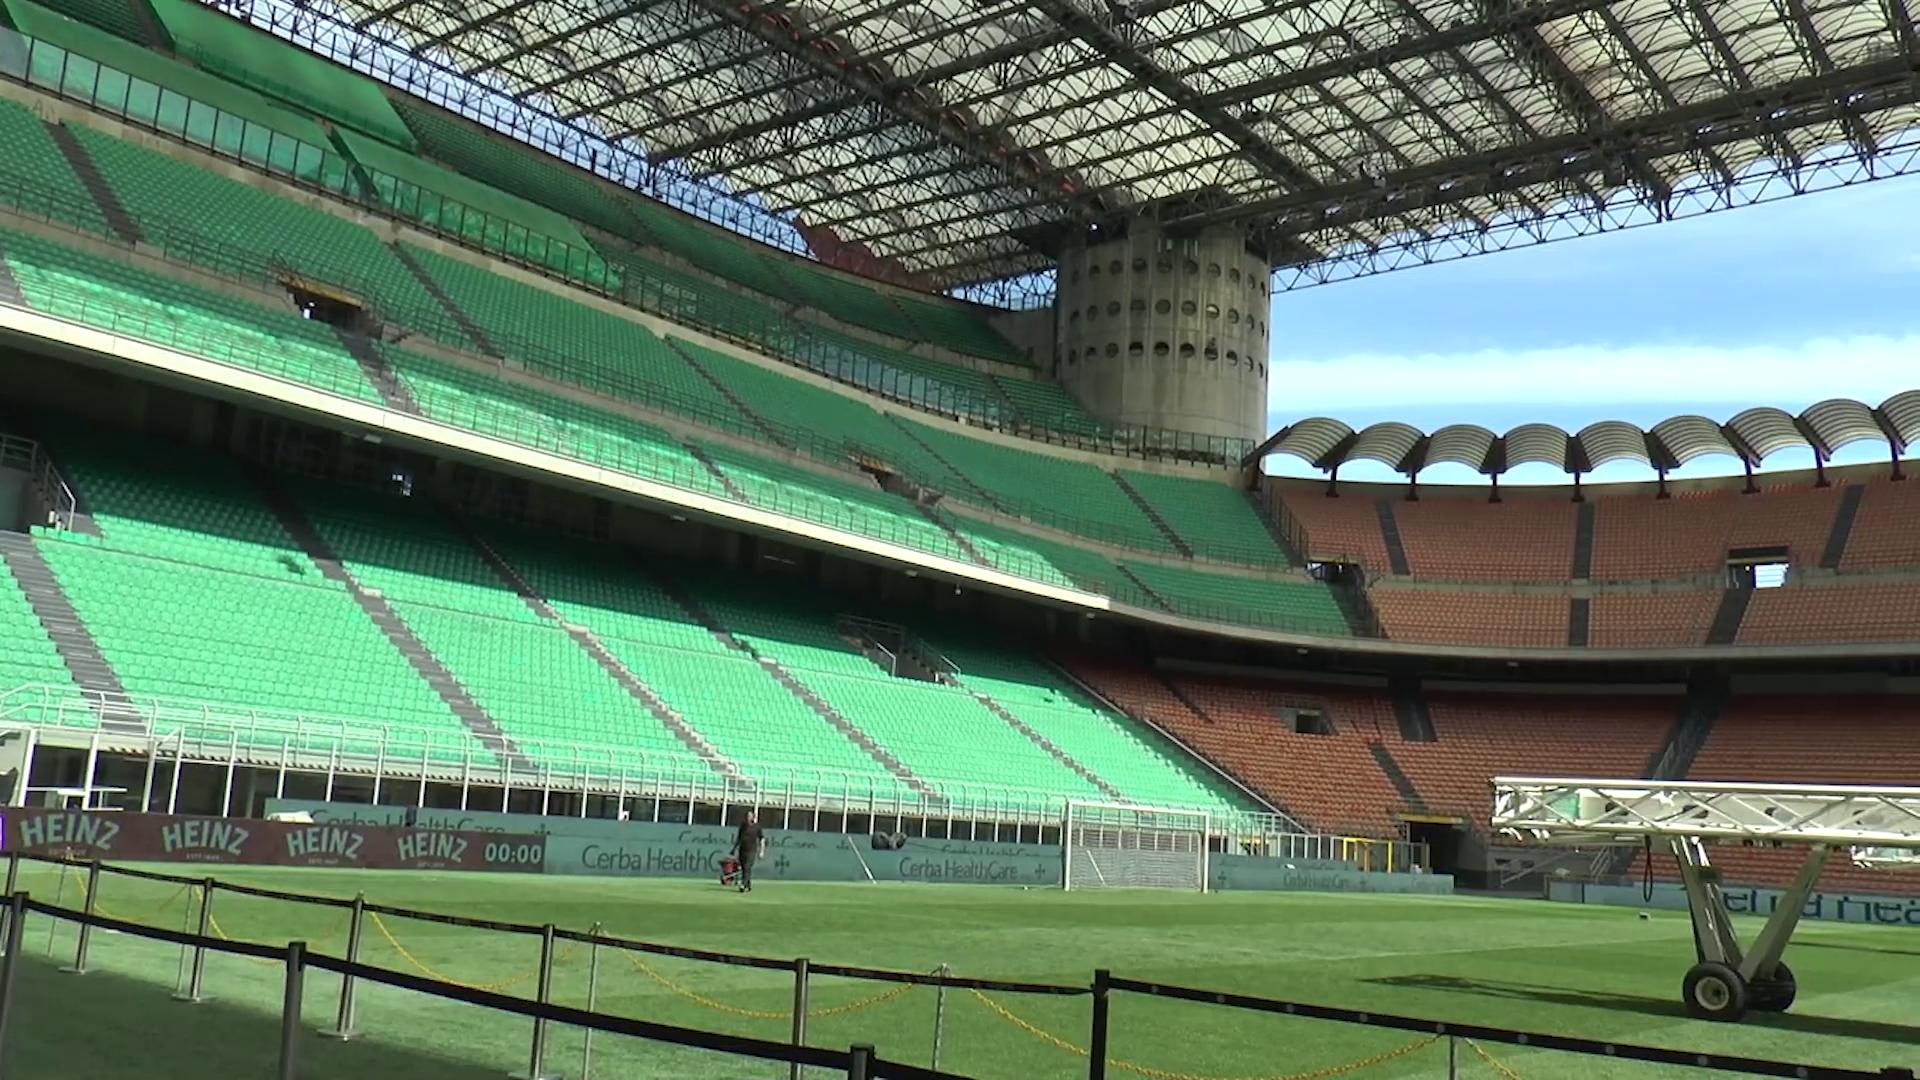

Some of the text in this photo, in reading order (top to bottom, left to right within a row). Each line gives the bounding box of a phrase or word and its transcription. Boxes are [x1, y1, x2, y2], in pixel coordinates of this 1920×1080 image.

[19, 812, 120, 850] HEINZ
[162, 819, 249, 855] HEINZ
[286, 827, 364, 859] HEINZ
[397, 832, 468, 863] HEINZ
[484, 842, 542, 864] 00:00
[582, 845, 727, 873] Cerba HealthC
[899, 856, 1018, 880] Cerba HealthCare
